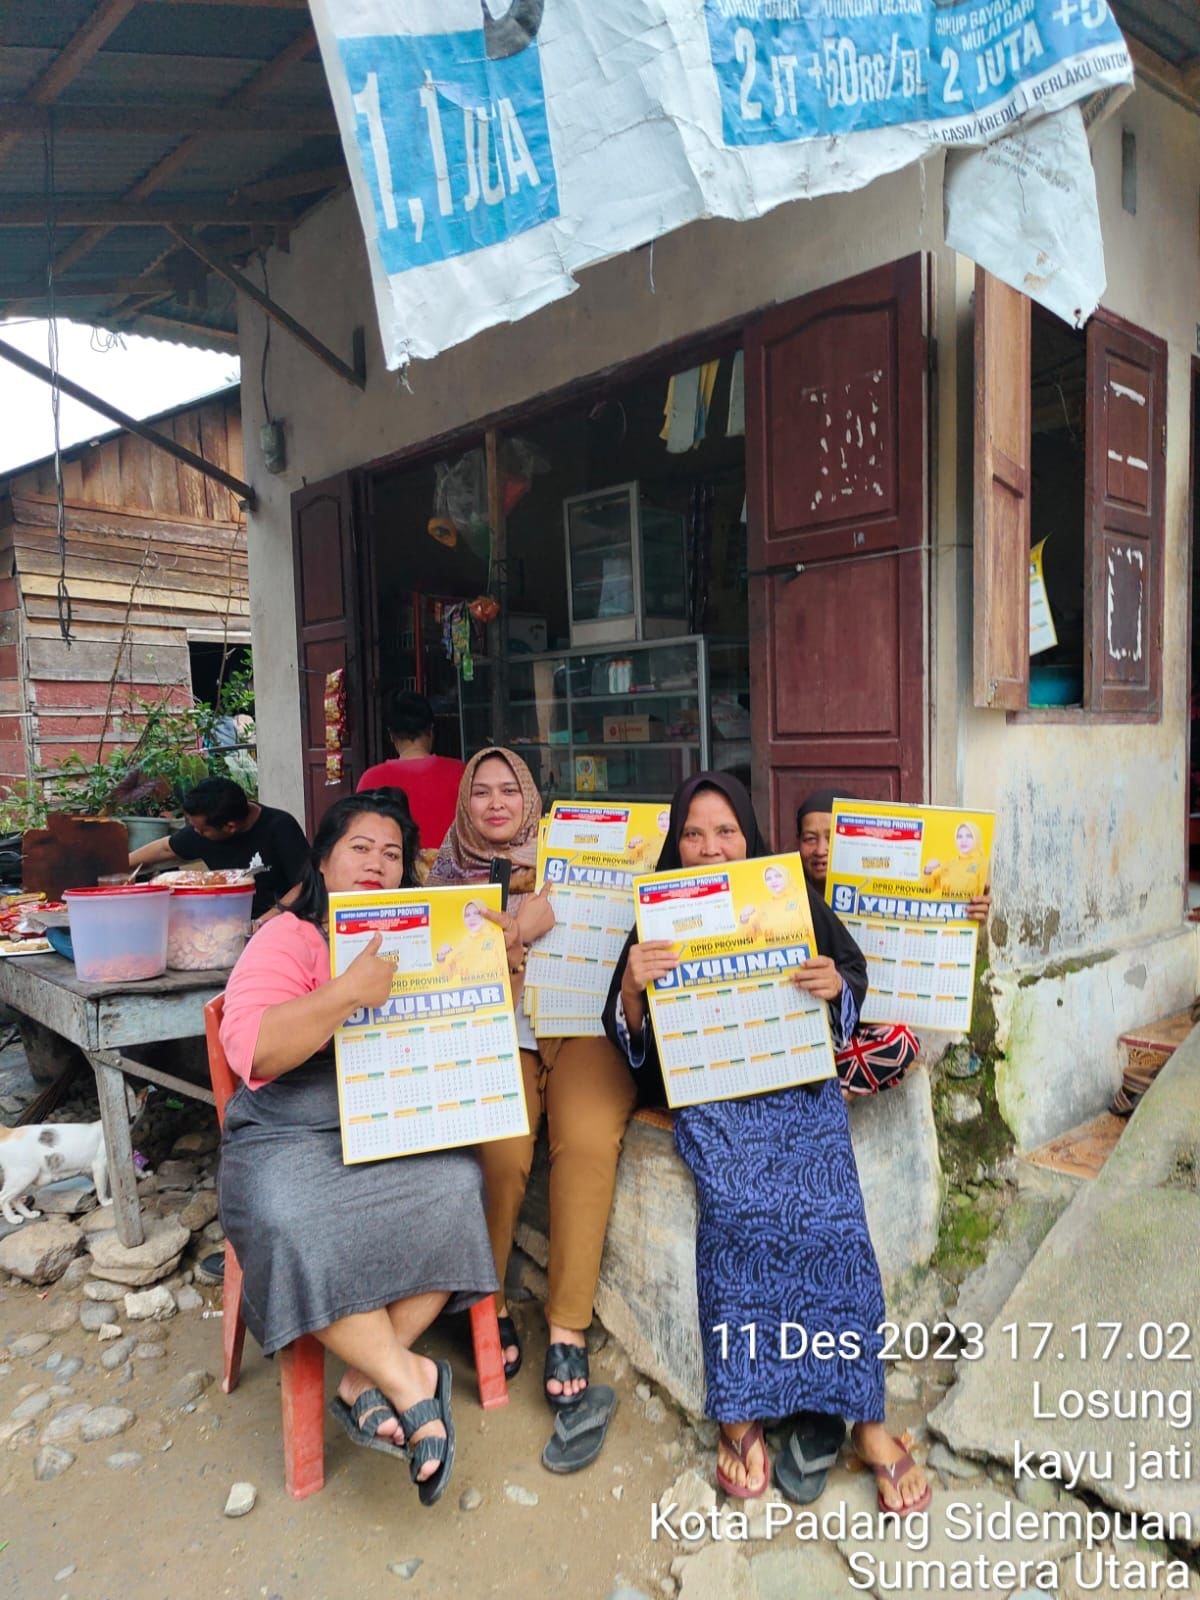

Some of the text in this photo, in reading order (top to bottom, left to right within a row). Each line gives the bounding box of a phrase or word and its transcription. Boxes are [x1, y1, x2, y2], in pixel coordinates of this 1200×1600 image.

[961, 18, 1001, 51] MULAI
[735, 27, 762, 120] 2
[771, 55, 798, 117] JT
[940, 20, 1044, 103] 2 JUTA
[1032, 61, 1093, 102] BERLAKU
[464, 98, 540, 211] JUA
[547, 859, 564, 883] 9
[835, 886, 852, 912] 9
[690, 937, 754, 953] DPRD PROVINSI
[683, 947, 807, 979] YULINAR
[391, 975, 449, 989] PRD PROVINSI
[379, 986, 500, 1017] YULINAR
